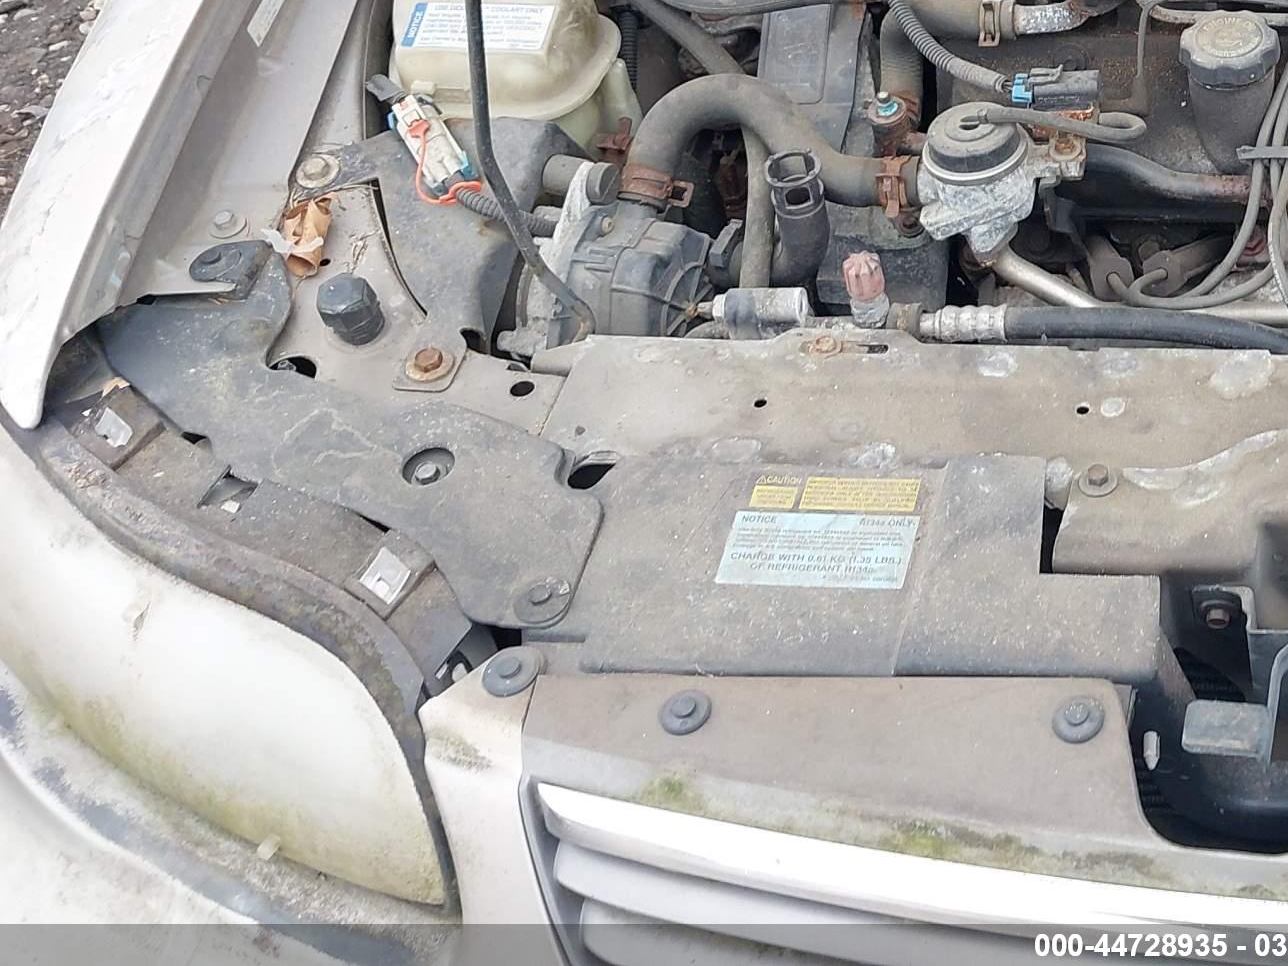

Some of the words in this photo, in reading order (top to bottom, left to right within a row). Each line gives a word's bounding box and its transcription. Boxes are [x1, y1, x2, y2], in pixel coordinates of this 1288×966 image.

[407, 10, 424, 38] NOTICE
[766, 475, 802, 485] CAUTION
[741, 514, 778, 524] NOTICE
[730, 551, 775, 562] CHARGE
[777, 552, 805, 562] WITH
[829, 555, 846, 564] KG
[749, 562, 764, 571] OF
[767, 563, 841, 572] REFRIGERANT
